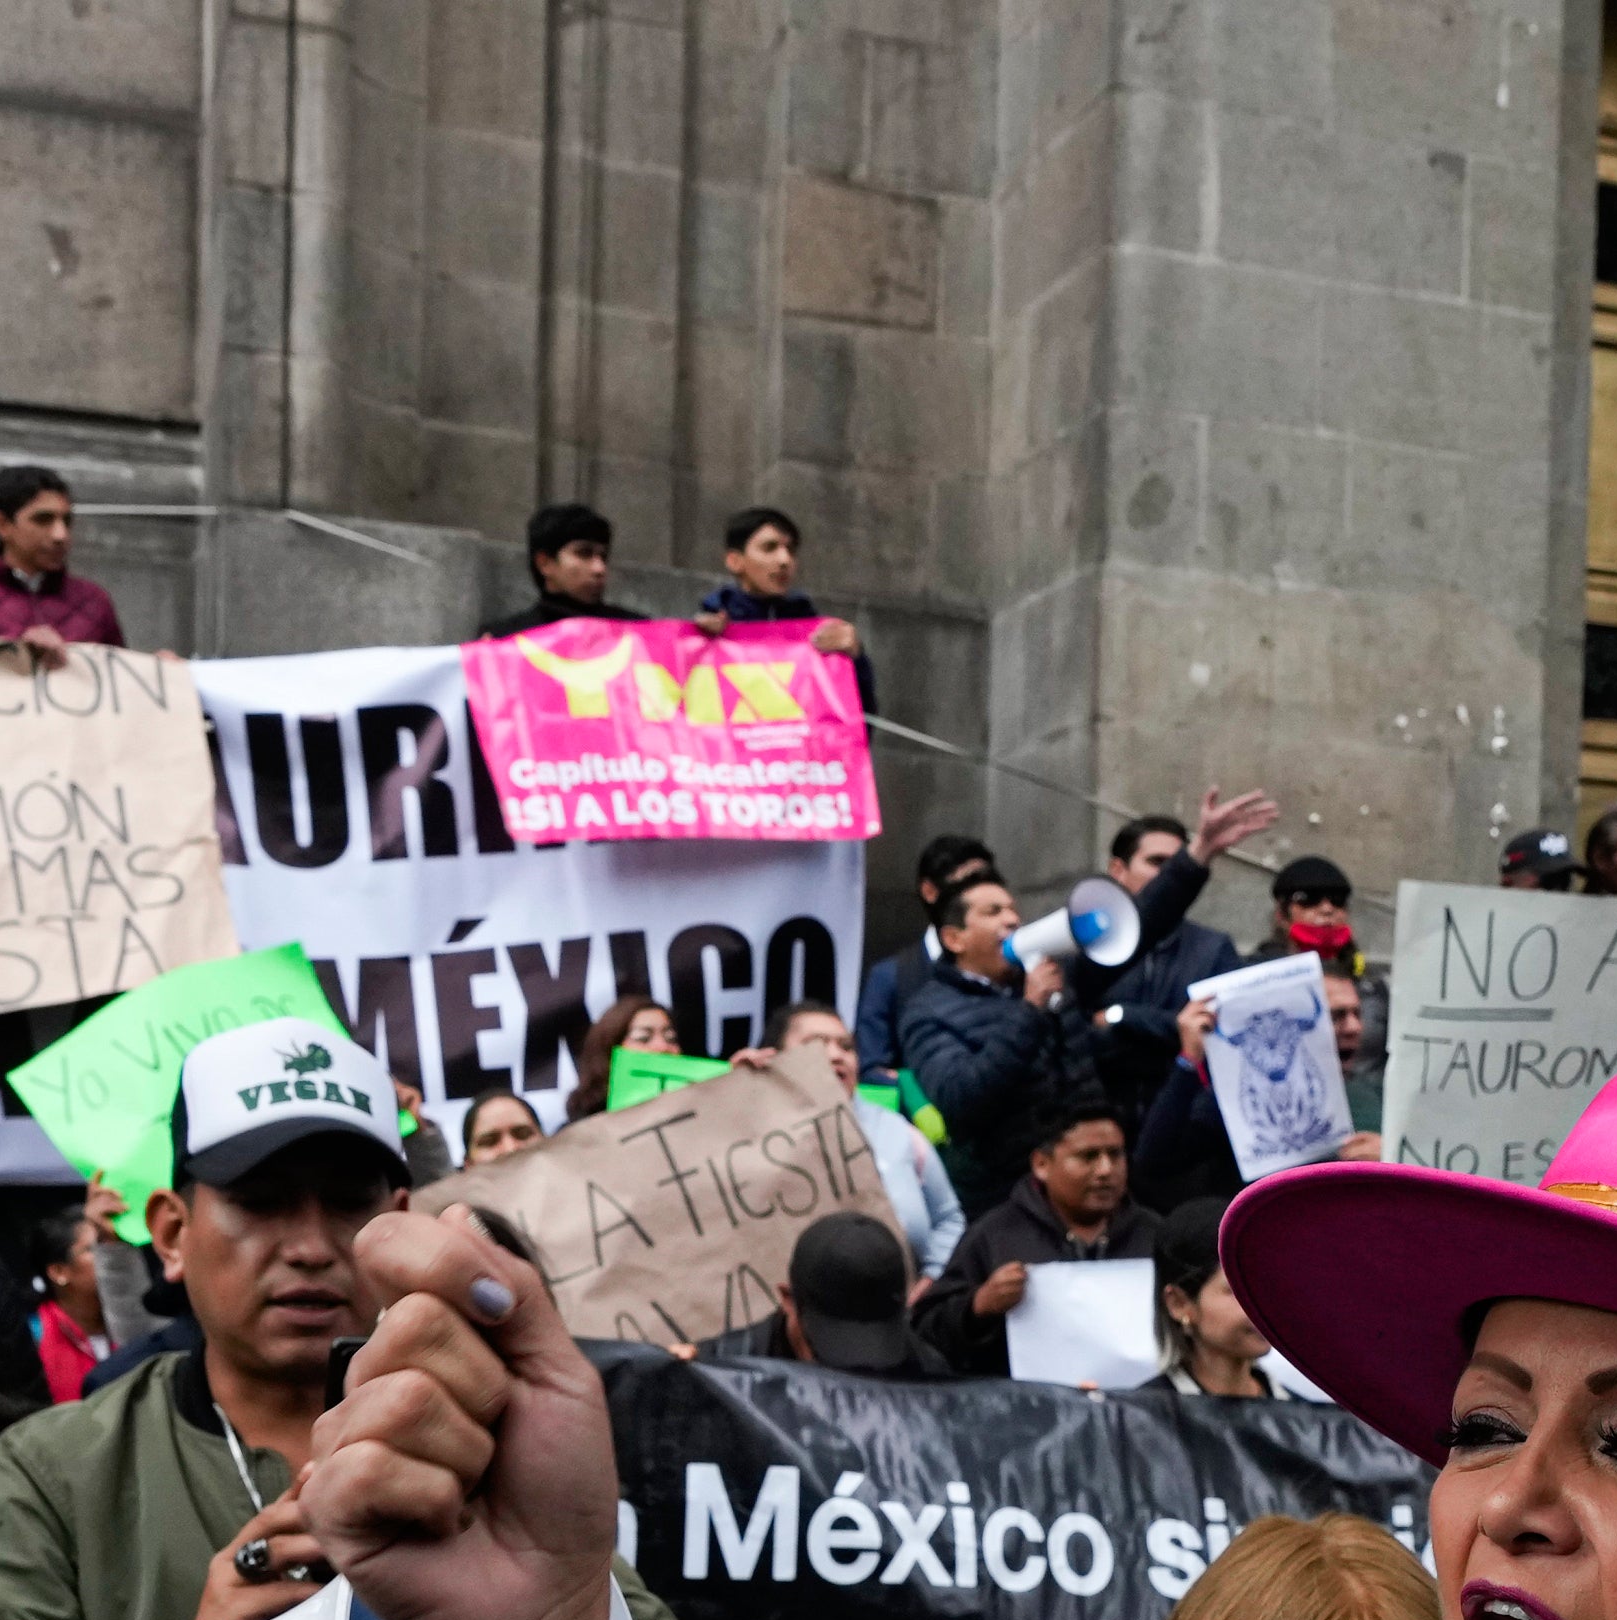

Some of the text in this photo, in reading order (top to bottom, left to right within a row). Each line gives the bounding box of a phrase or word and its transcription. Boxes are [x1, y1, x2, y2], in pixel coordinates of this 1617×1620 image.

[670, 755, 848, 788] Zacatecas
[574, 793, 610, 829] A
[613, 789, 699, 826] LOS
[700, 790, 854, 830] TOROS!
[1439, 904, 1560, 1001] NO
[237, 1077, 373, 1117] VEGAN
[682, 1461, 1115, 1597] México
